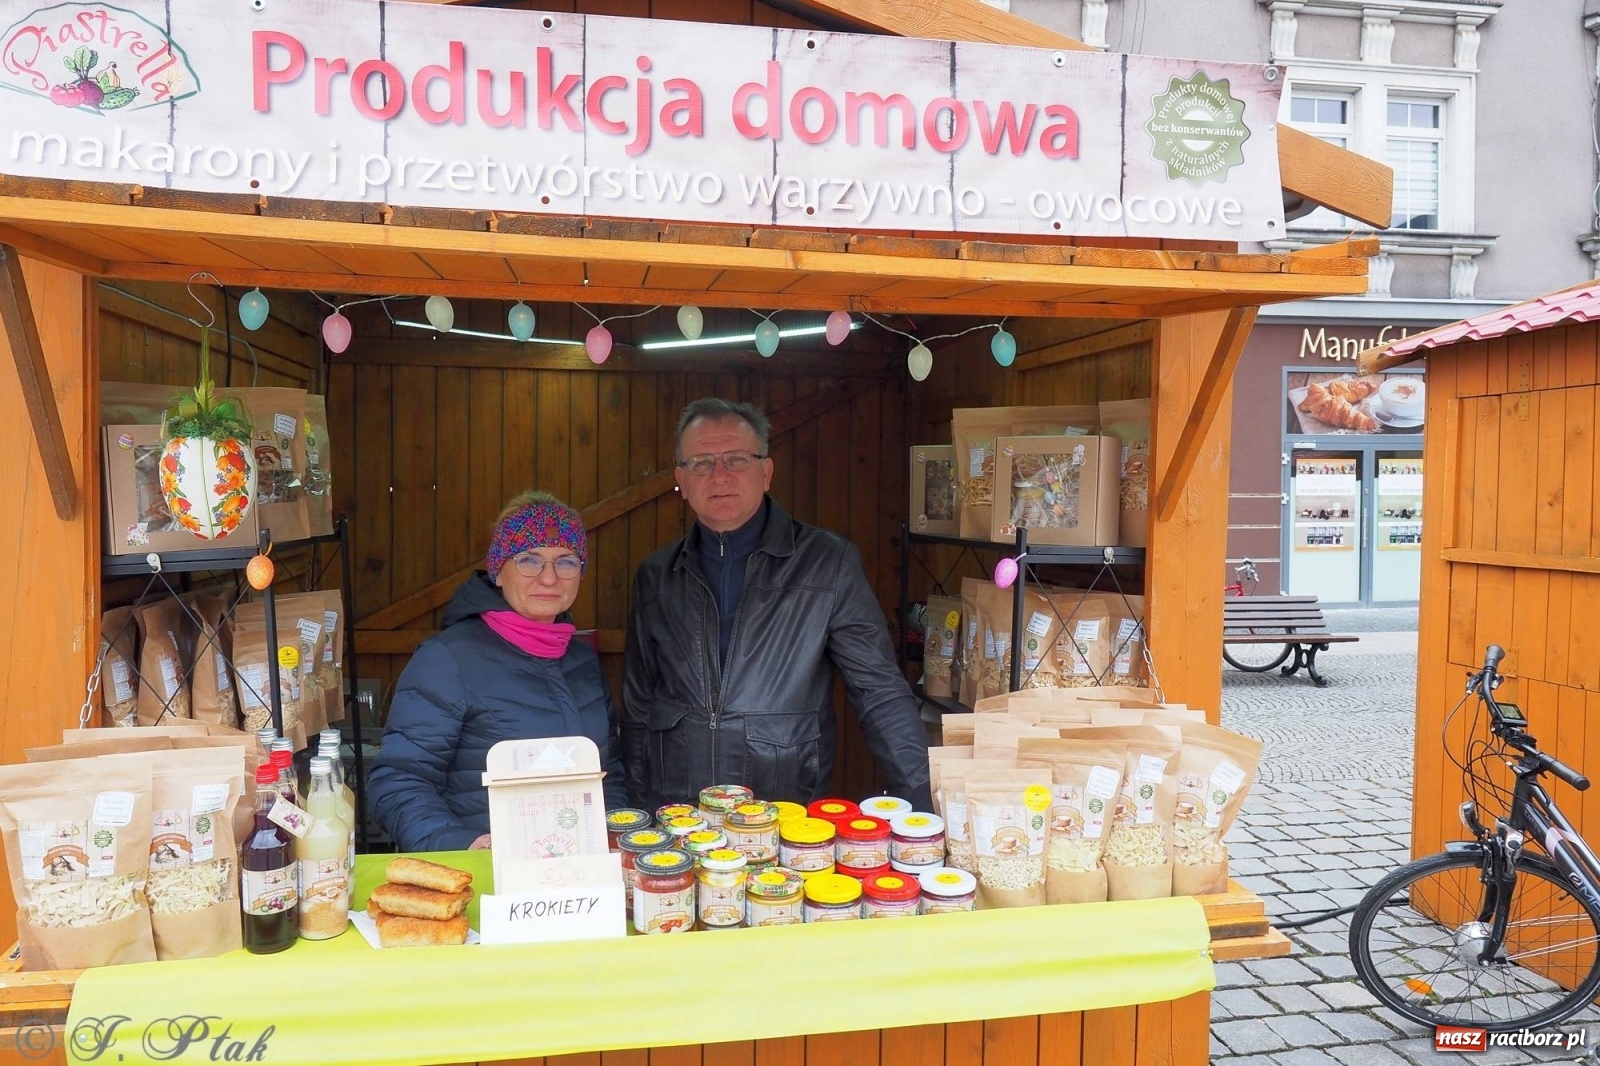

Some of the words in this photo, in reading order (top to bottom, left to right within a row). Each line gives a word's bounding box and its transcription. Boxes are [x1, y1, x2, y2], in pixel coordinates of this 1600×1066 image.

[251, 30, 704, 156] Produkcja
[731, 60, 1079, 160] domowa
[1158, 83, 1198, 119] Produkty
[1199, 82, 1237, 123] domowej
[1174, 96, 1222, 118] produkcji
[1151, 121, 1169, 133] bez
[1171, 123, 1244, 137] konserwantów
[1165, 138, 1173, 147] z
[1171, 140, 1230, 165] naturalnych
[10, 126, 310, 191] makarony
[328, 142, 338, 184] i
[358, 148, 722, 204] przetwórstwo
[742, 174, 985, 223] warzywno
[1029, 186, 1243, 226] owocowe
[1168, 157, 1226, 177] składników
[509, 897, 599, 921] KROKIETY
